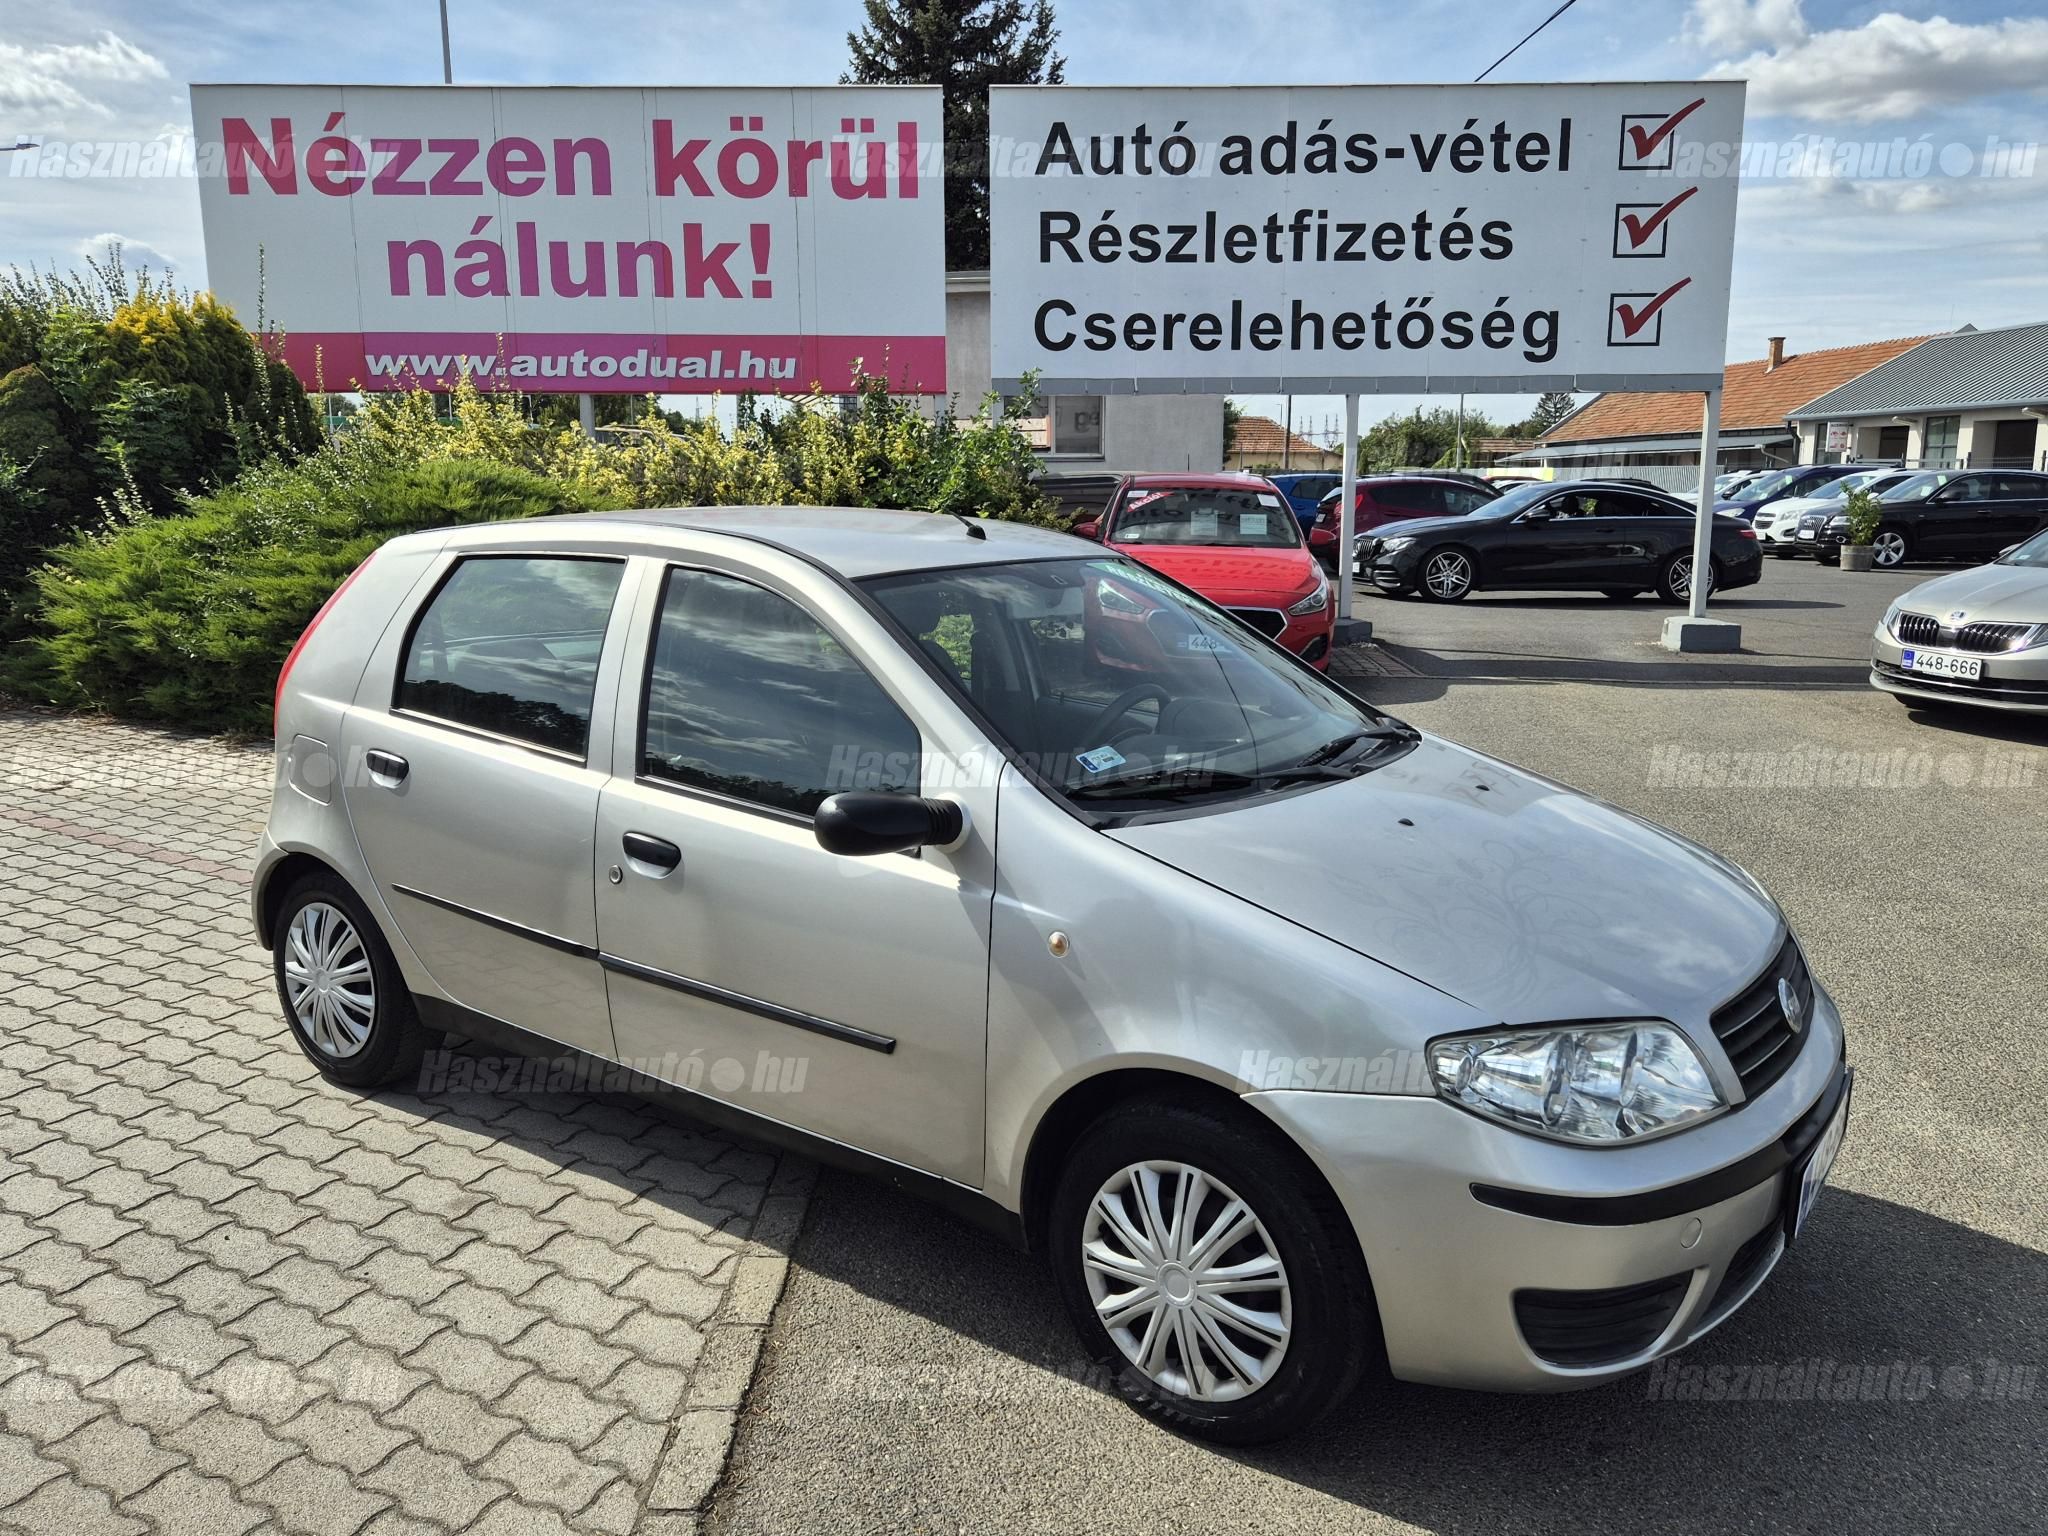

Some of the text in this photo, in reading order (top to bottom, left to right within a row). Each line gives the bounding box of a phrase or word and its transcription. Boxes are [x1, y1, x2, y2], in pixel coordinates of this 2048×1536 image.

[221, 111, 919, 200] Nézzen körül
[1034, 118, 1572, 176] Autó adás-vétel
[387, 216, 772, 299] nálunk!
[1038, 207, 1513, 263] Részletfizetés
[1033, 296, 1559, 363] Cserelehetőség
[364, 348, 797, 379] www.autodual.hu
[1916, 654, 1978, 676] 448-666
